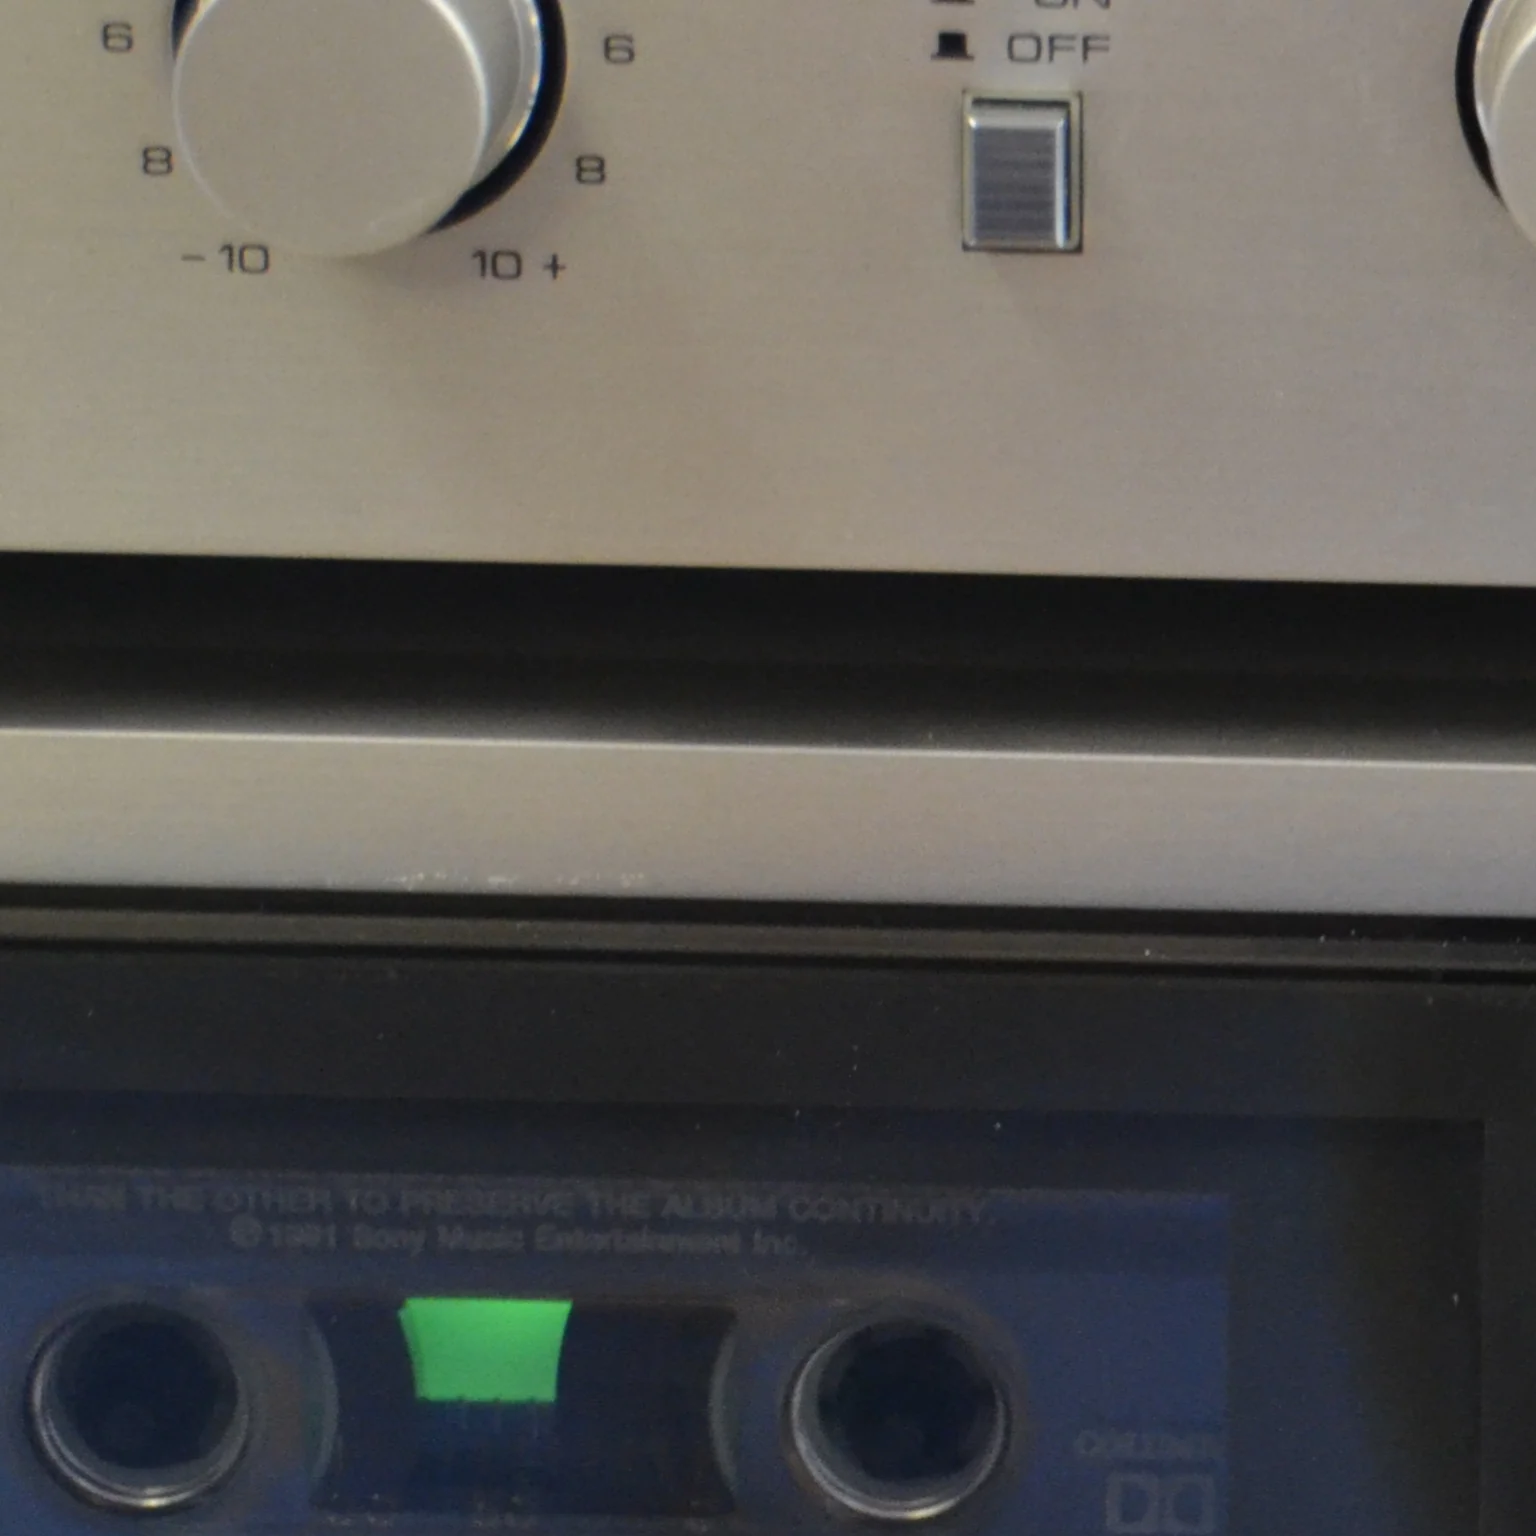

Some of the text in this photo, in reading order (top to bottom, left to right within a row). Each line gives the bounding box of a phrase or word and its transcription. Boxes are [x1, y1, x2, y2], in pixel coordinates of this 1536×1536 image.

[101, 22, 134, 52] 6
[602, 33, 636, 64] 6
[1006, 32, 1109, 63] OFF
[141, 146, 174, 176] 8
[574, 154, 606, 185] 8
[471, 248, 523, 280] 10
